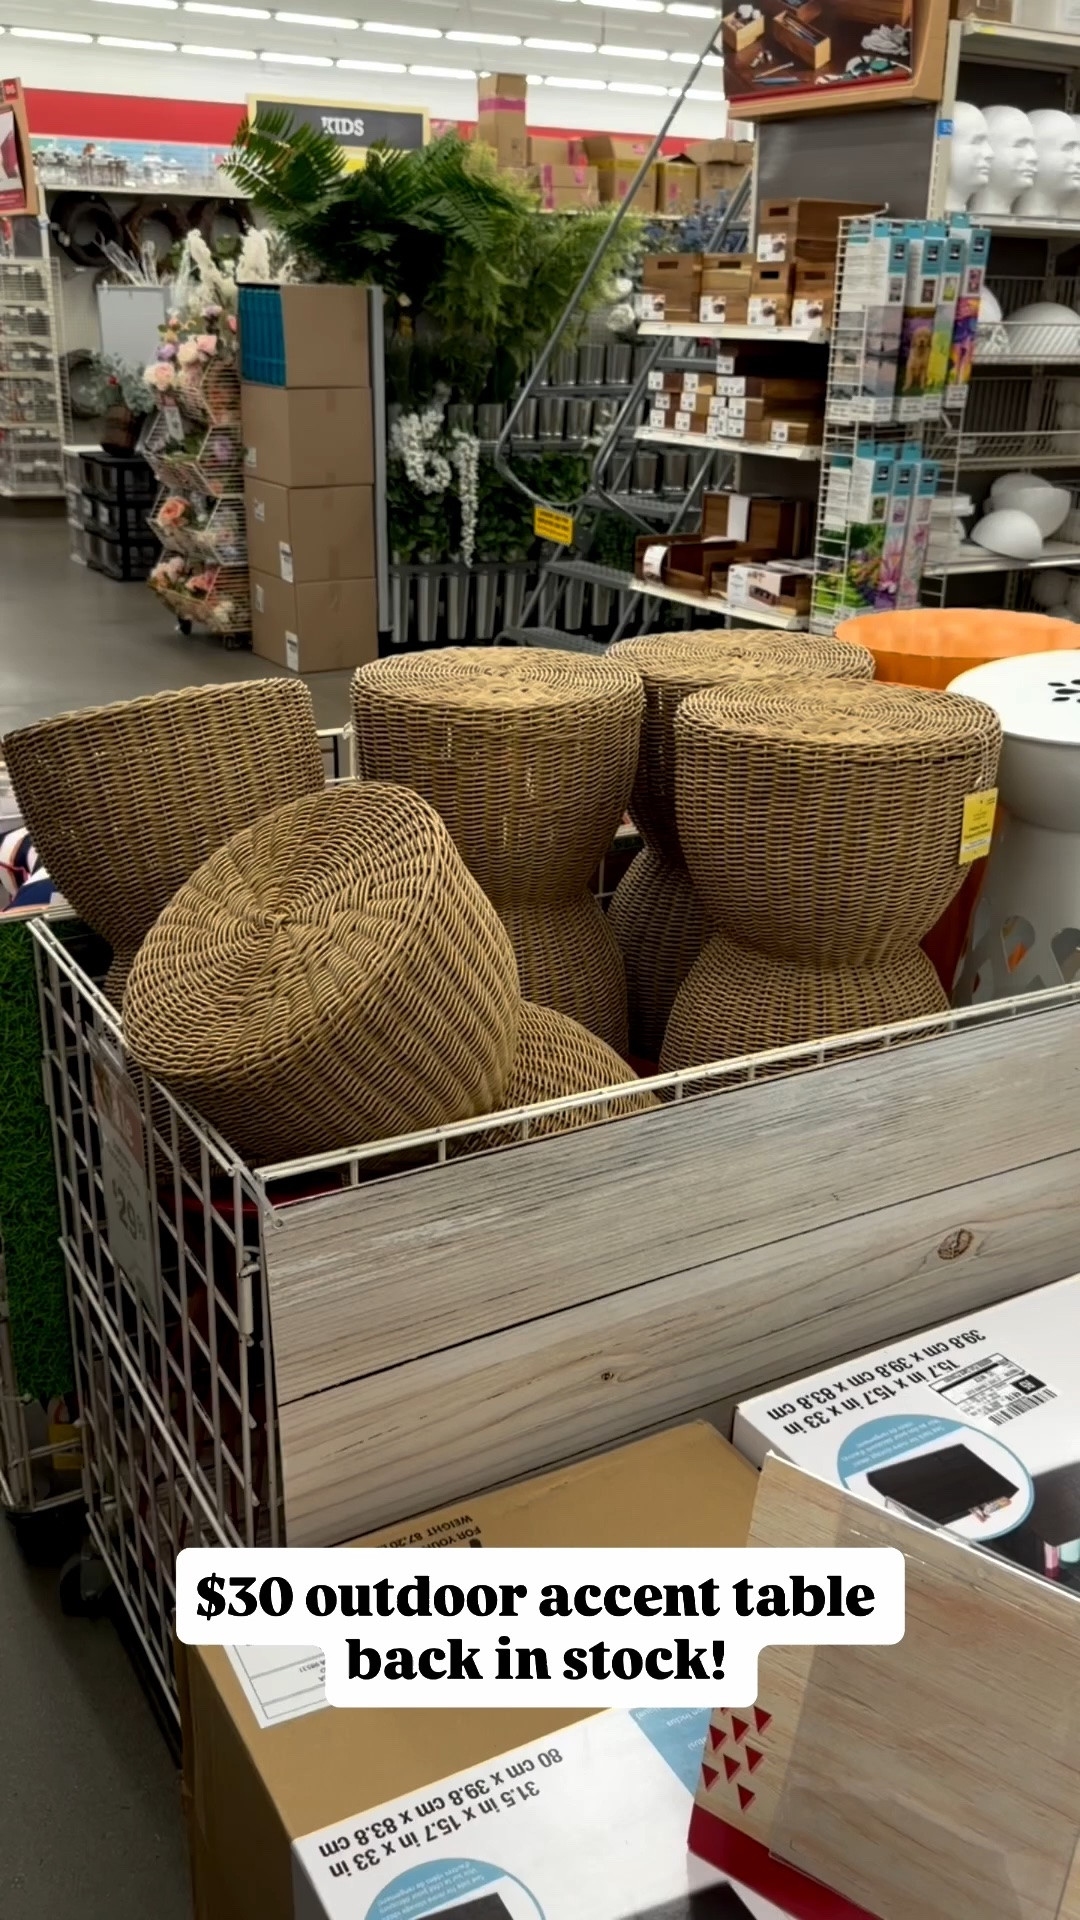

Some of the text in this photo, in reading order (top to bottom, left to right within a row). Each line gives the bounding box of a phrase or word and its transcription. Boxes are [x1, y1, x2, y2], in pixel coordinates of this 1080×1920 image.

[321, 116, 365, 137] KIDS
[767, 1329, 987, 1421] 39.8 cm x 39.8 cm x 83.8 cm
[906, 1371, 928, 1384] in
[928, 1359, 960, 1378] 15.7
[893, 1379, 909, 1390] x
[841, 1396, 865, 1411] in
[863, 1384, 897, 1406] 15.7
[804, 1411, 830, 1429] 33
[827, 1405, 844, 1417] x
[783, 1421, 808, 1435] in
[426, 1514, 473, 1537] WEIGHT
[456, 1526, 482, 1540] FOR
[318, 1748, 563, 1858] 80 cm x 39.8 cm x 83.8 cm
[329, 1781, 540, 1878] 31.5 in x 15.7 in x 33 in
